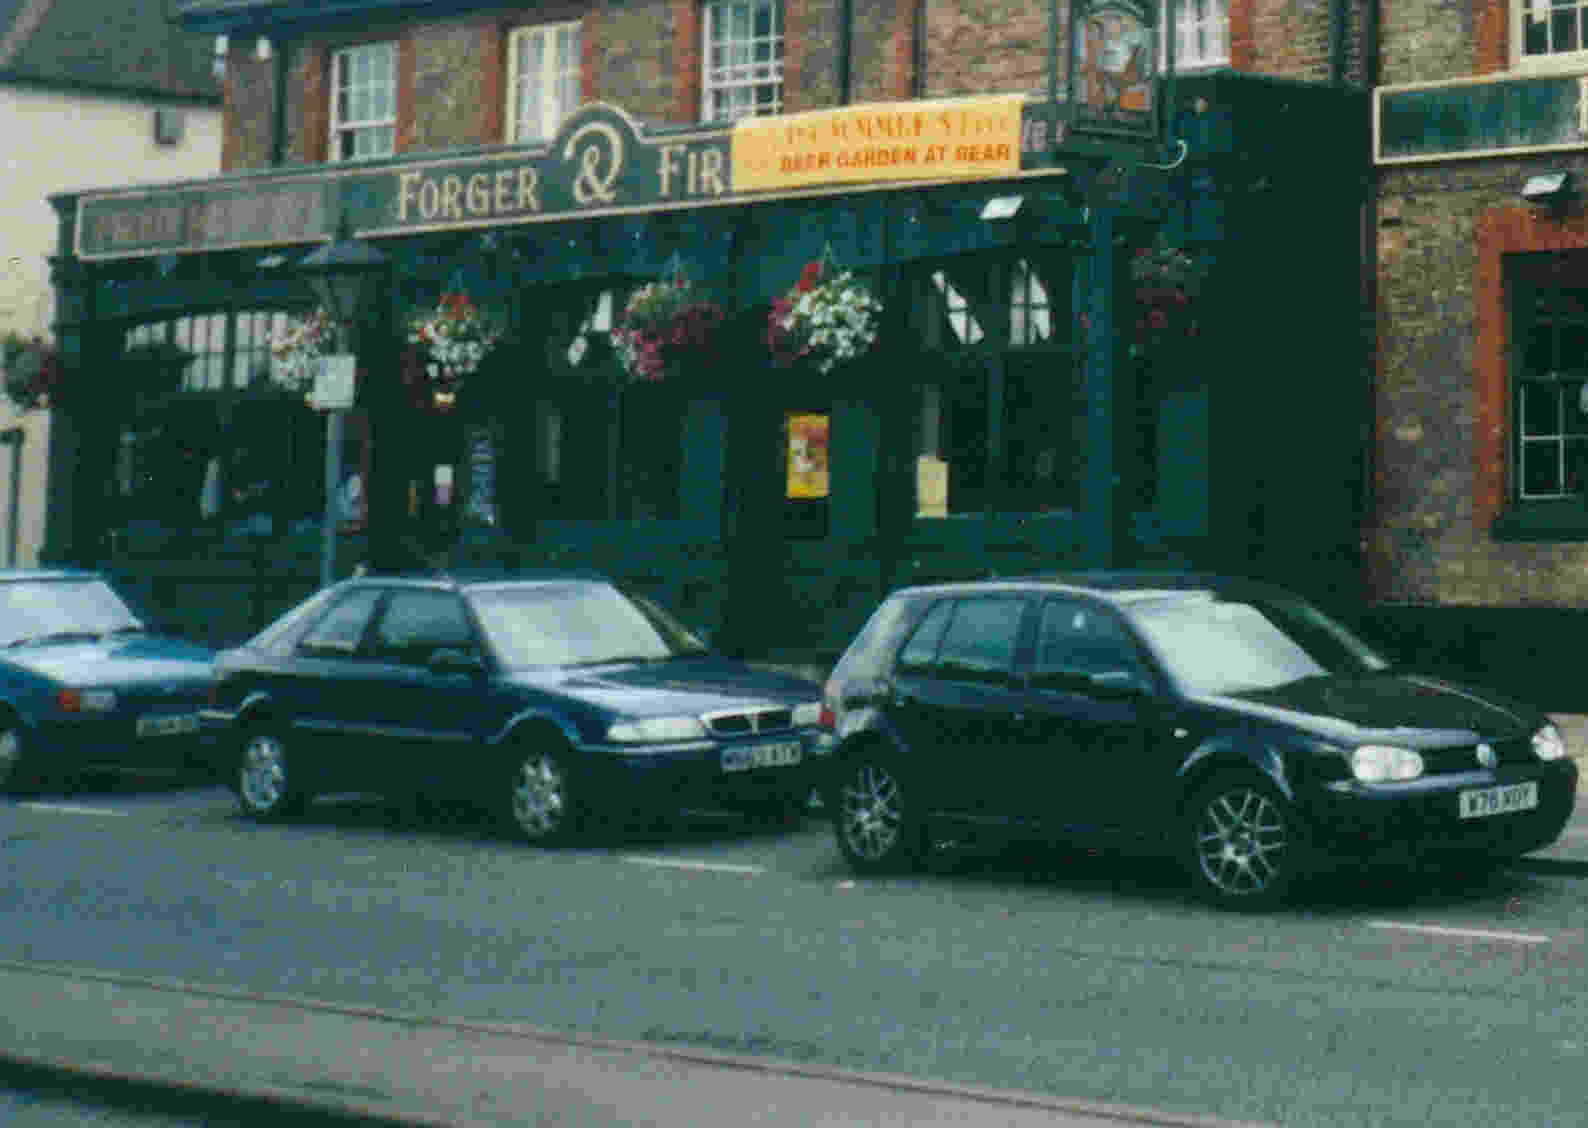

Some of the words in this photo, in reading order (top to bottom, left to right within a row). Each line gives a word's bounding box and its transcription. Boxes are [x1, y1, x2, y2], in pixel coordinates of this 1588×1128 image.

[398, 165, 541, 223] FORGER
[563, 121, 624, 204] &
[655, 140, 736, 200] FIR
[836, 143, 919, 170] GARDEN
[924, 143, 948, 165] AT
[953, 141, 1011, 164] REAR
